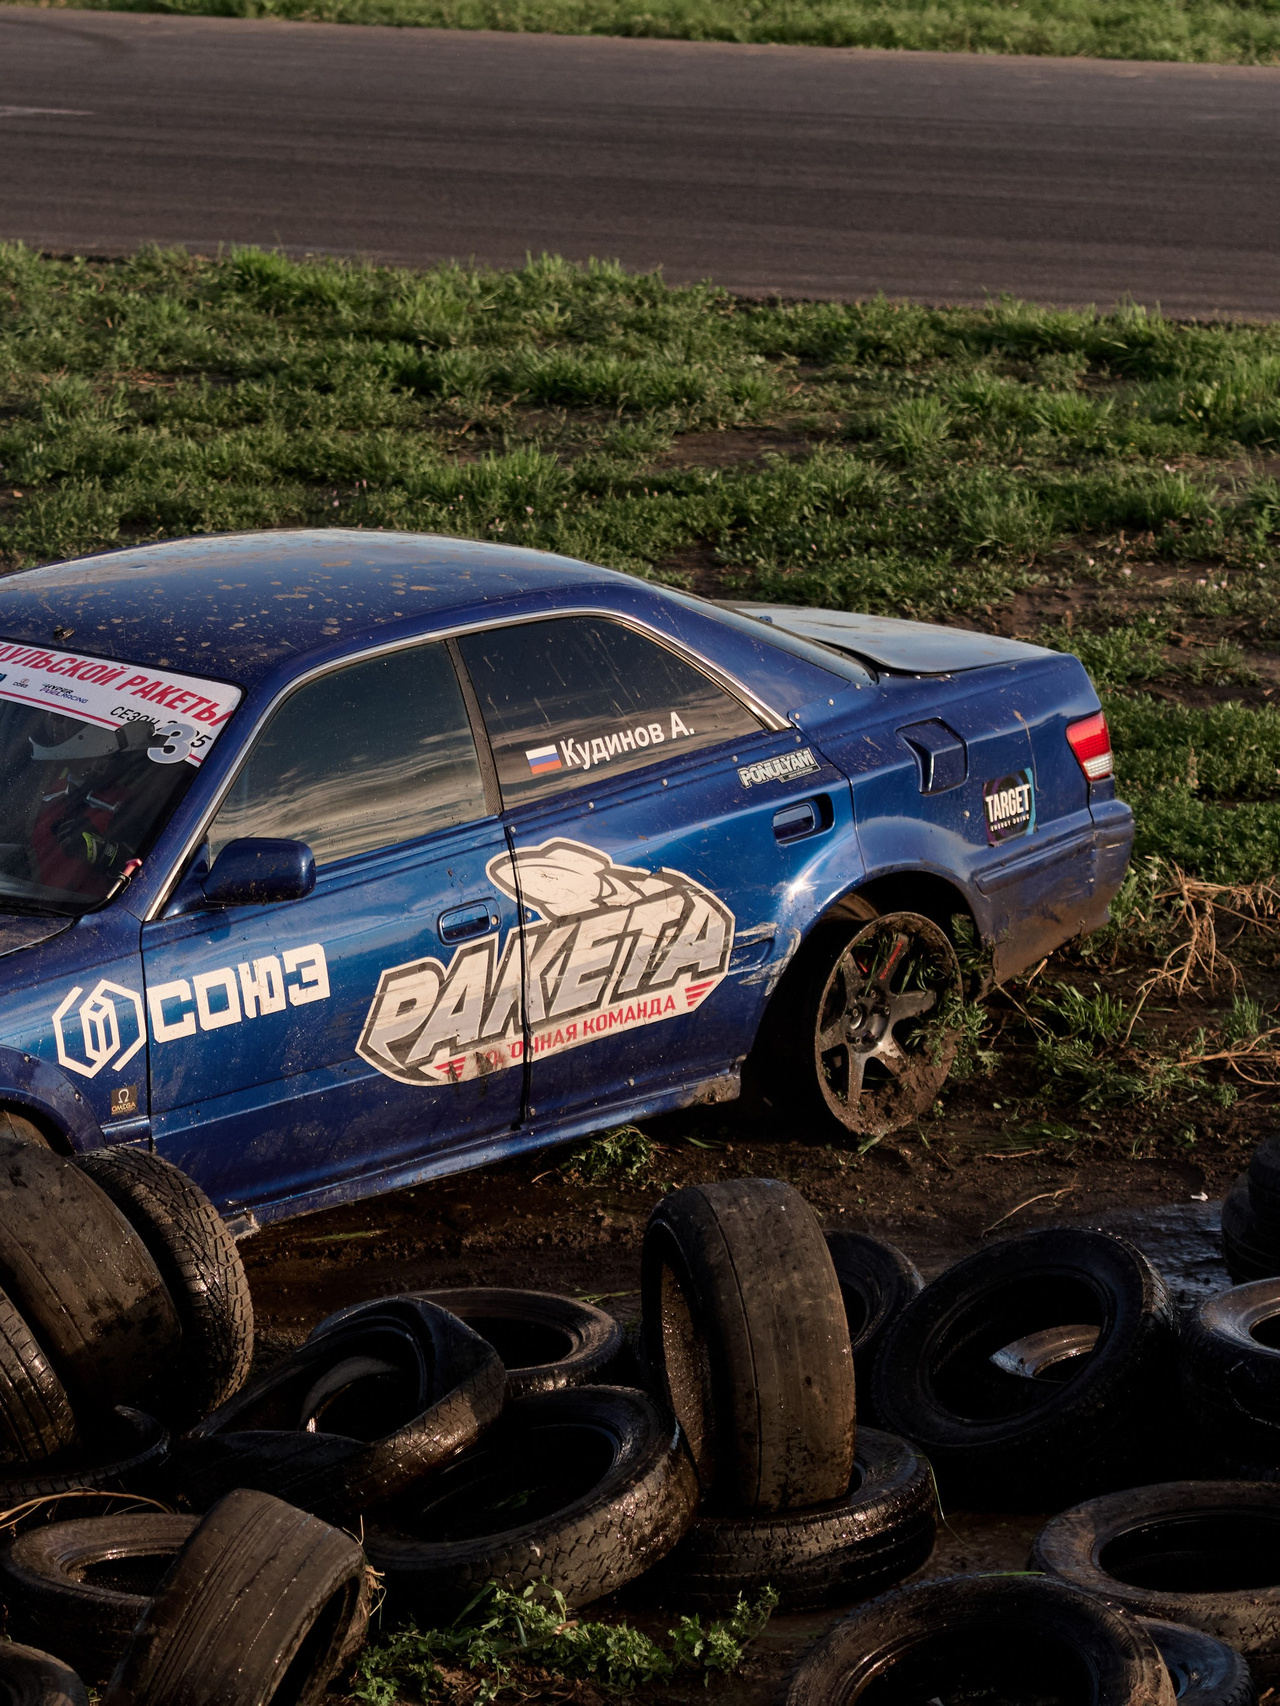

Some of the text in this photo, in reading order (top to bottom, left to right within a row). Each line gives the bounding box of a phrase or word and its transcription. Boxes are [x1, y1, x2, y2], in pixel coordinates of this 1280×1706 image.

[115, 675, 234, 727] РАКЕТЫ
[147, 722, 198, 765] 3
[559, 711, 695, 770] Кудинов А.
[739, 749, 815, 787] PONULYAM
[985, 783, 1031, 823] TARGET
[990, 820, 1011, 832] ENERGY
[146, 943, 331, 1044] СОЮЗ
[366, 900, 723, 1070] РАКЕТА
[583, 995, 676, 1038] КОМАНДА
[111, 1101, 137, 1112] OMEGA
